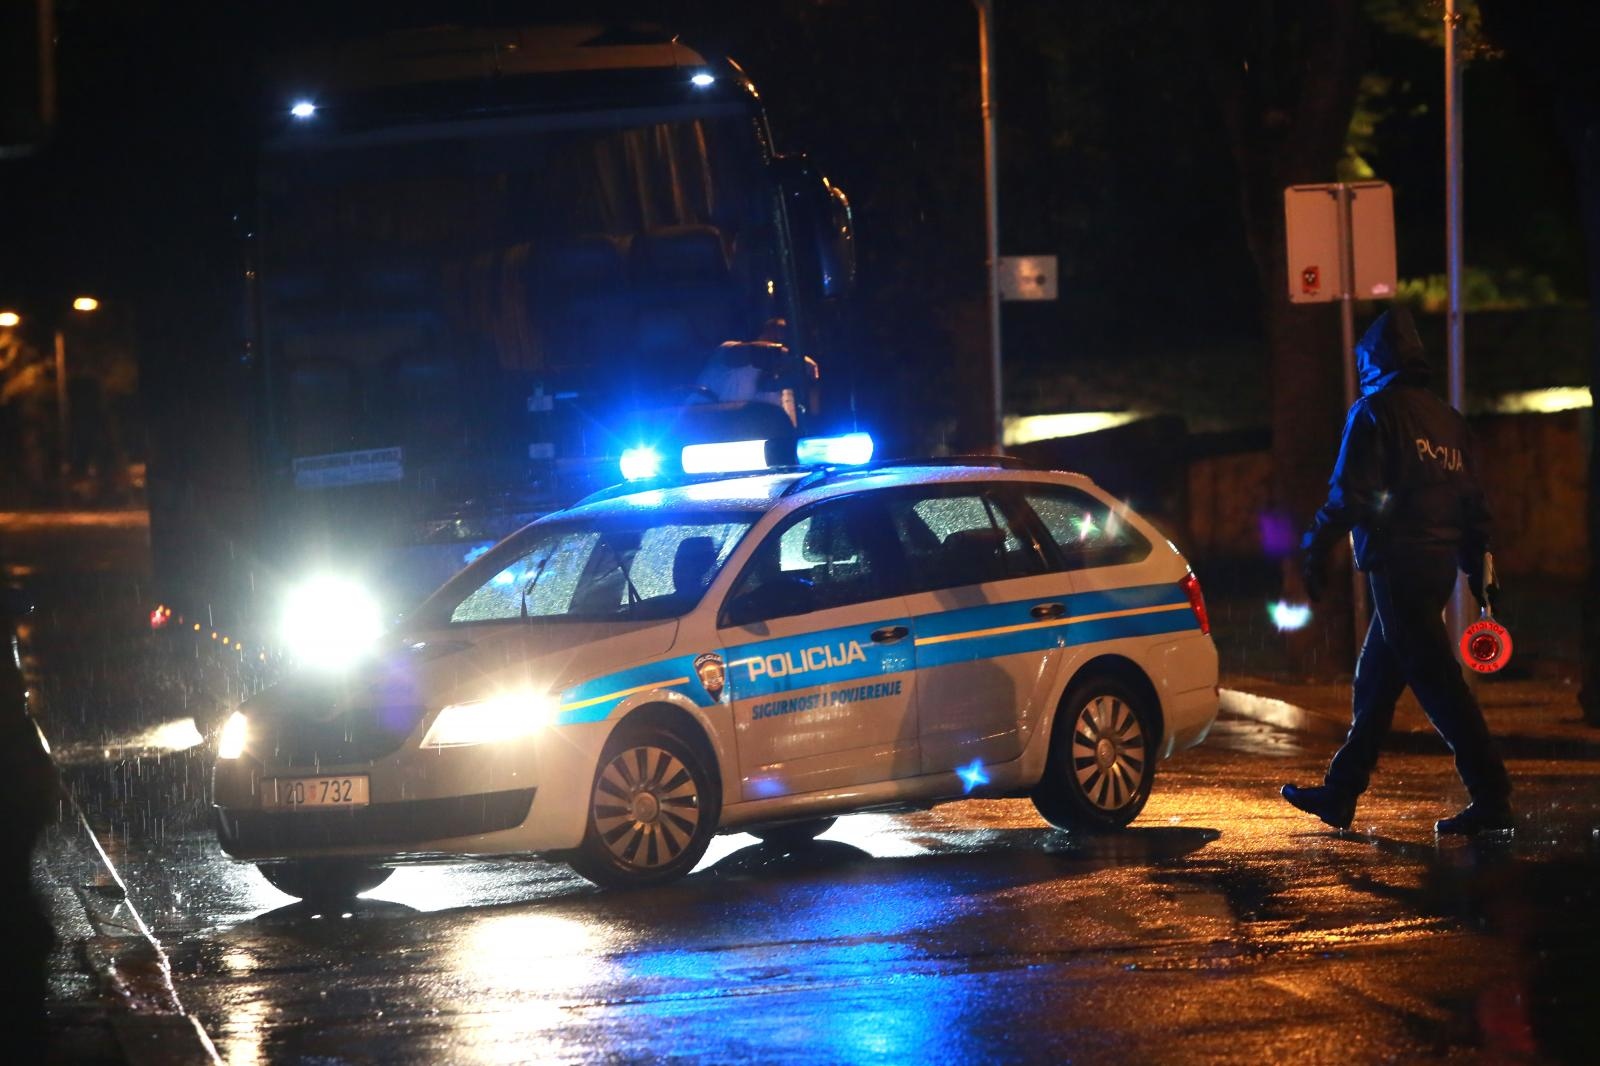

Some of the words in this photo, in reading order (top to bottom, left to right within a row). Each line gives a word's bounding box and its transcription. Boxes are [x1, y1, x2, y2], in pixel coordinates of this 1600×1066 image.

[1467, 623, 1504, 635] POLICIJA
[749, 640, 866, 682] POLICIJA
[1471, 662, 1498, 671] STOP
[752, 694, 820, 720] SIGURNOST
[831, 681, 902, 705] POVJERENJE
[320, 780, 352, 803] 732
